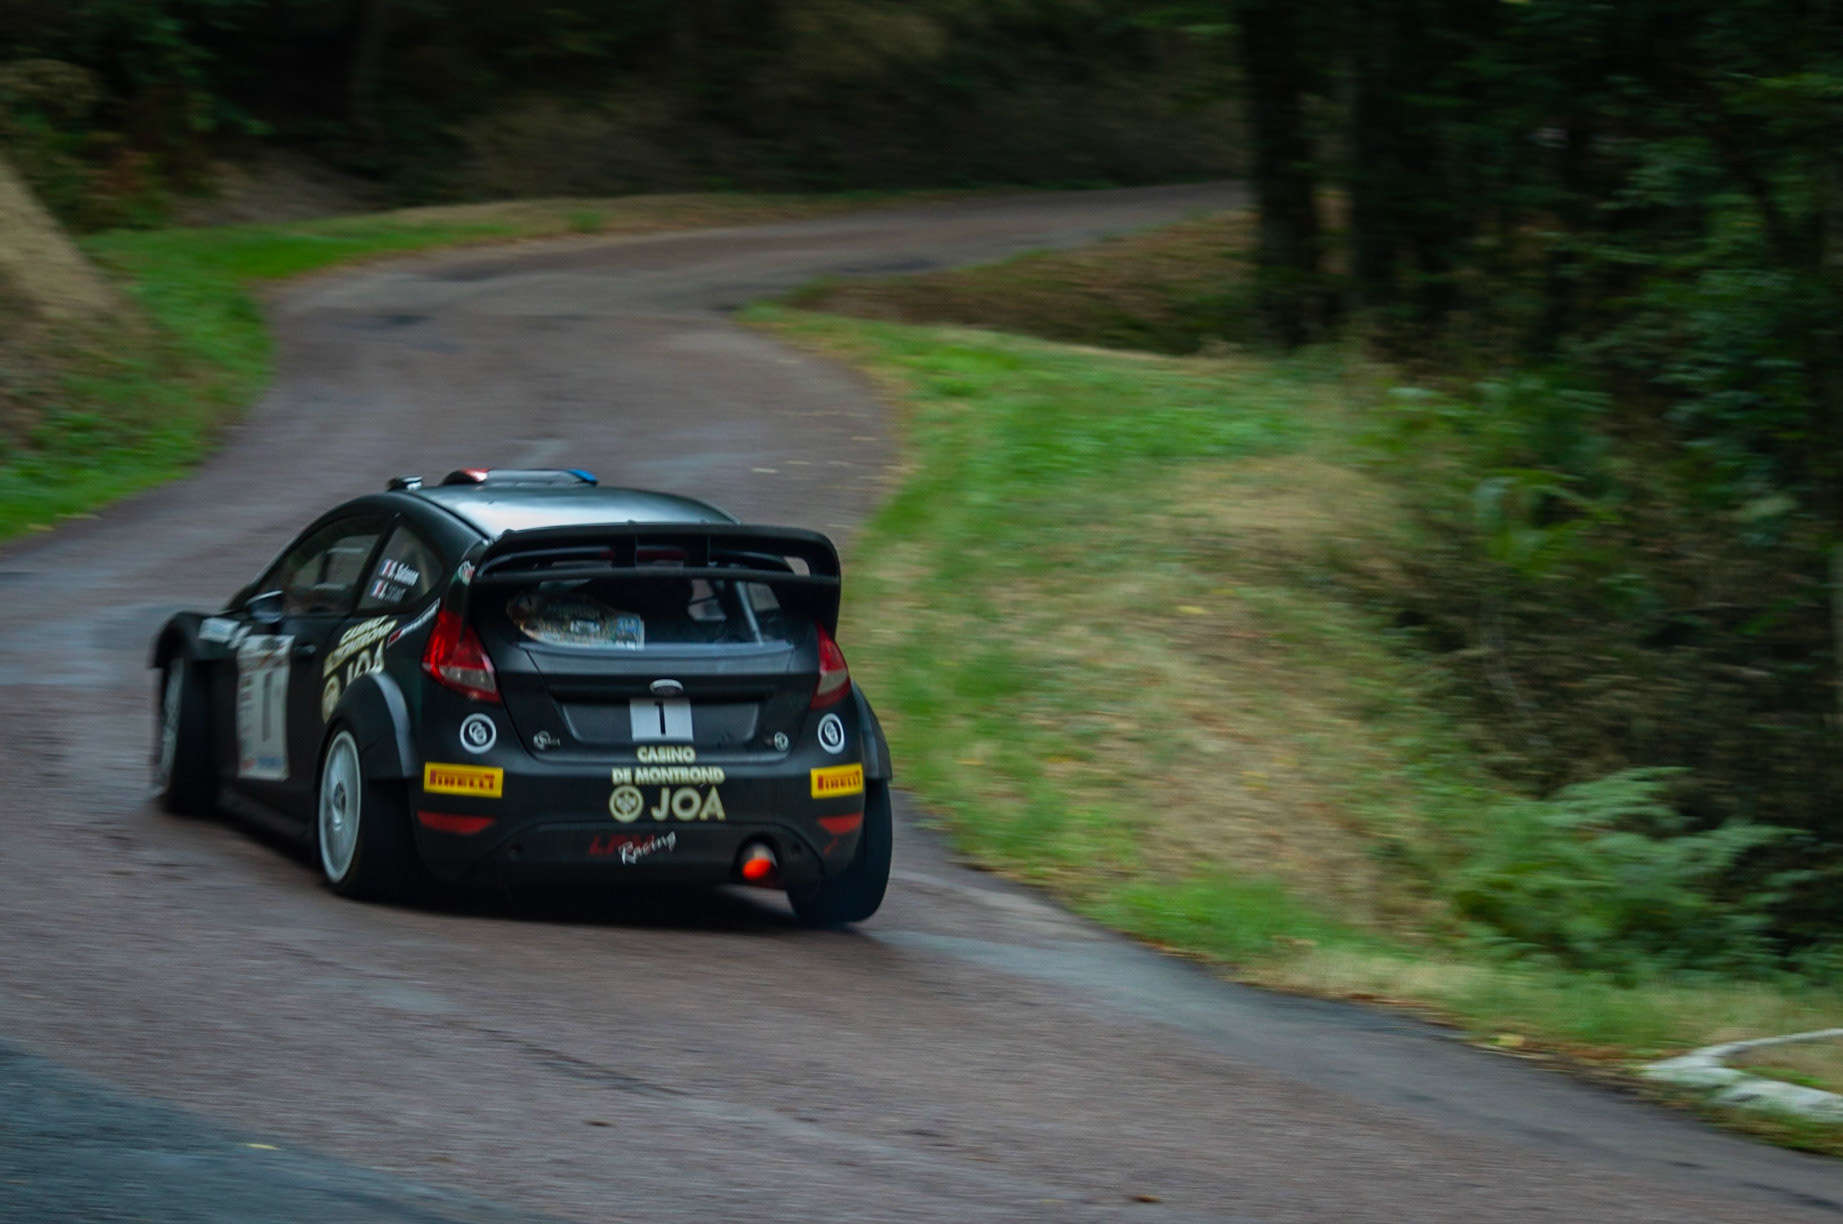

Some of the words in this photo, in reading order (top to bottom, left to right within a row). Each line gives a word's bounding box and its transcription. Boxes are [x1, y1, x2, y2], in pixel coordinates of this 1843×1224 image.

[654, 701, 667, 736] 1
[636, 746, 697, 764] CASINO
[611, 767, 633, 786] DE
[634, 766, 726, 786] MONTROND
[650, 785, 727, 822] JOA
[618, 830, 677, 865] Racing
